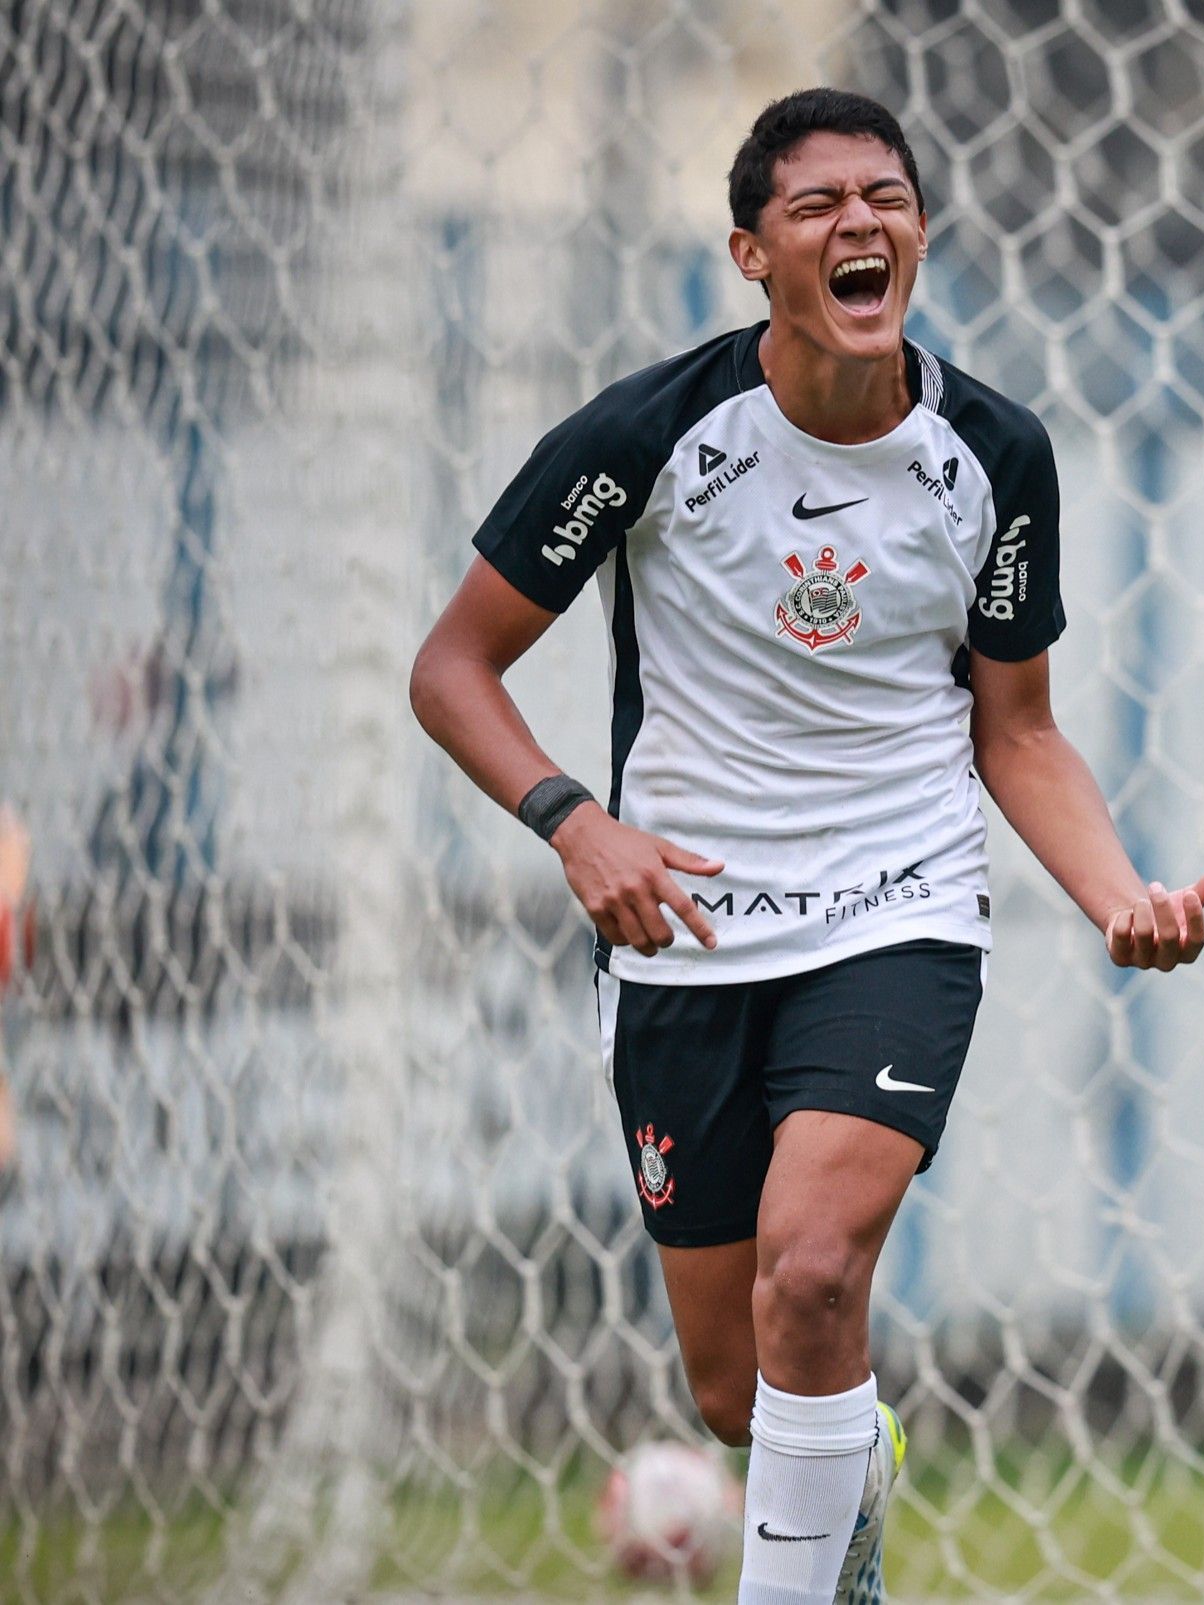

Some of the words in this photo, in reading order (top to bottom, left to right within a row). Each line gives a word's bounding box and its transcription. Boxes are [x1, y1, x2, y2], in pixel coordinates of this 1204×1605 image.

[561, 475, 588, 510] banco
[684, 476, 727, 513] Perfil
[723, 450, 761, 484] Líder
[907, 460, 944, 500] Perfil
[553, 472, 627, 545] bmg
[978, 539, 1027, 621] bmg
[1018, 561, 1029, 602] banco
[825, 882, 931, 924] FITNESS
